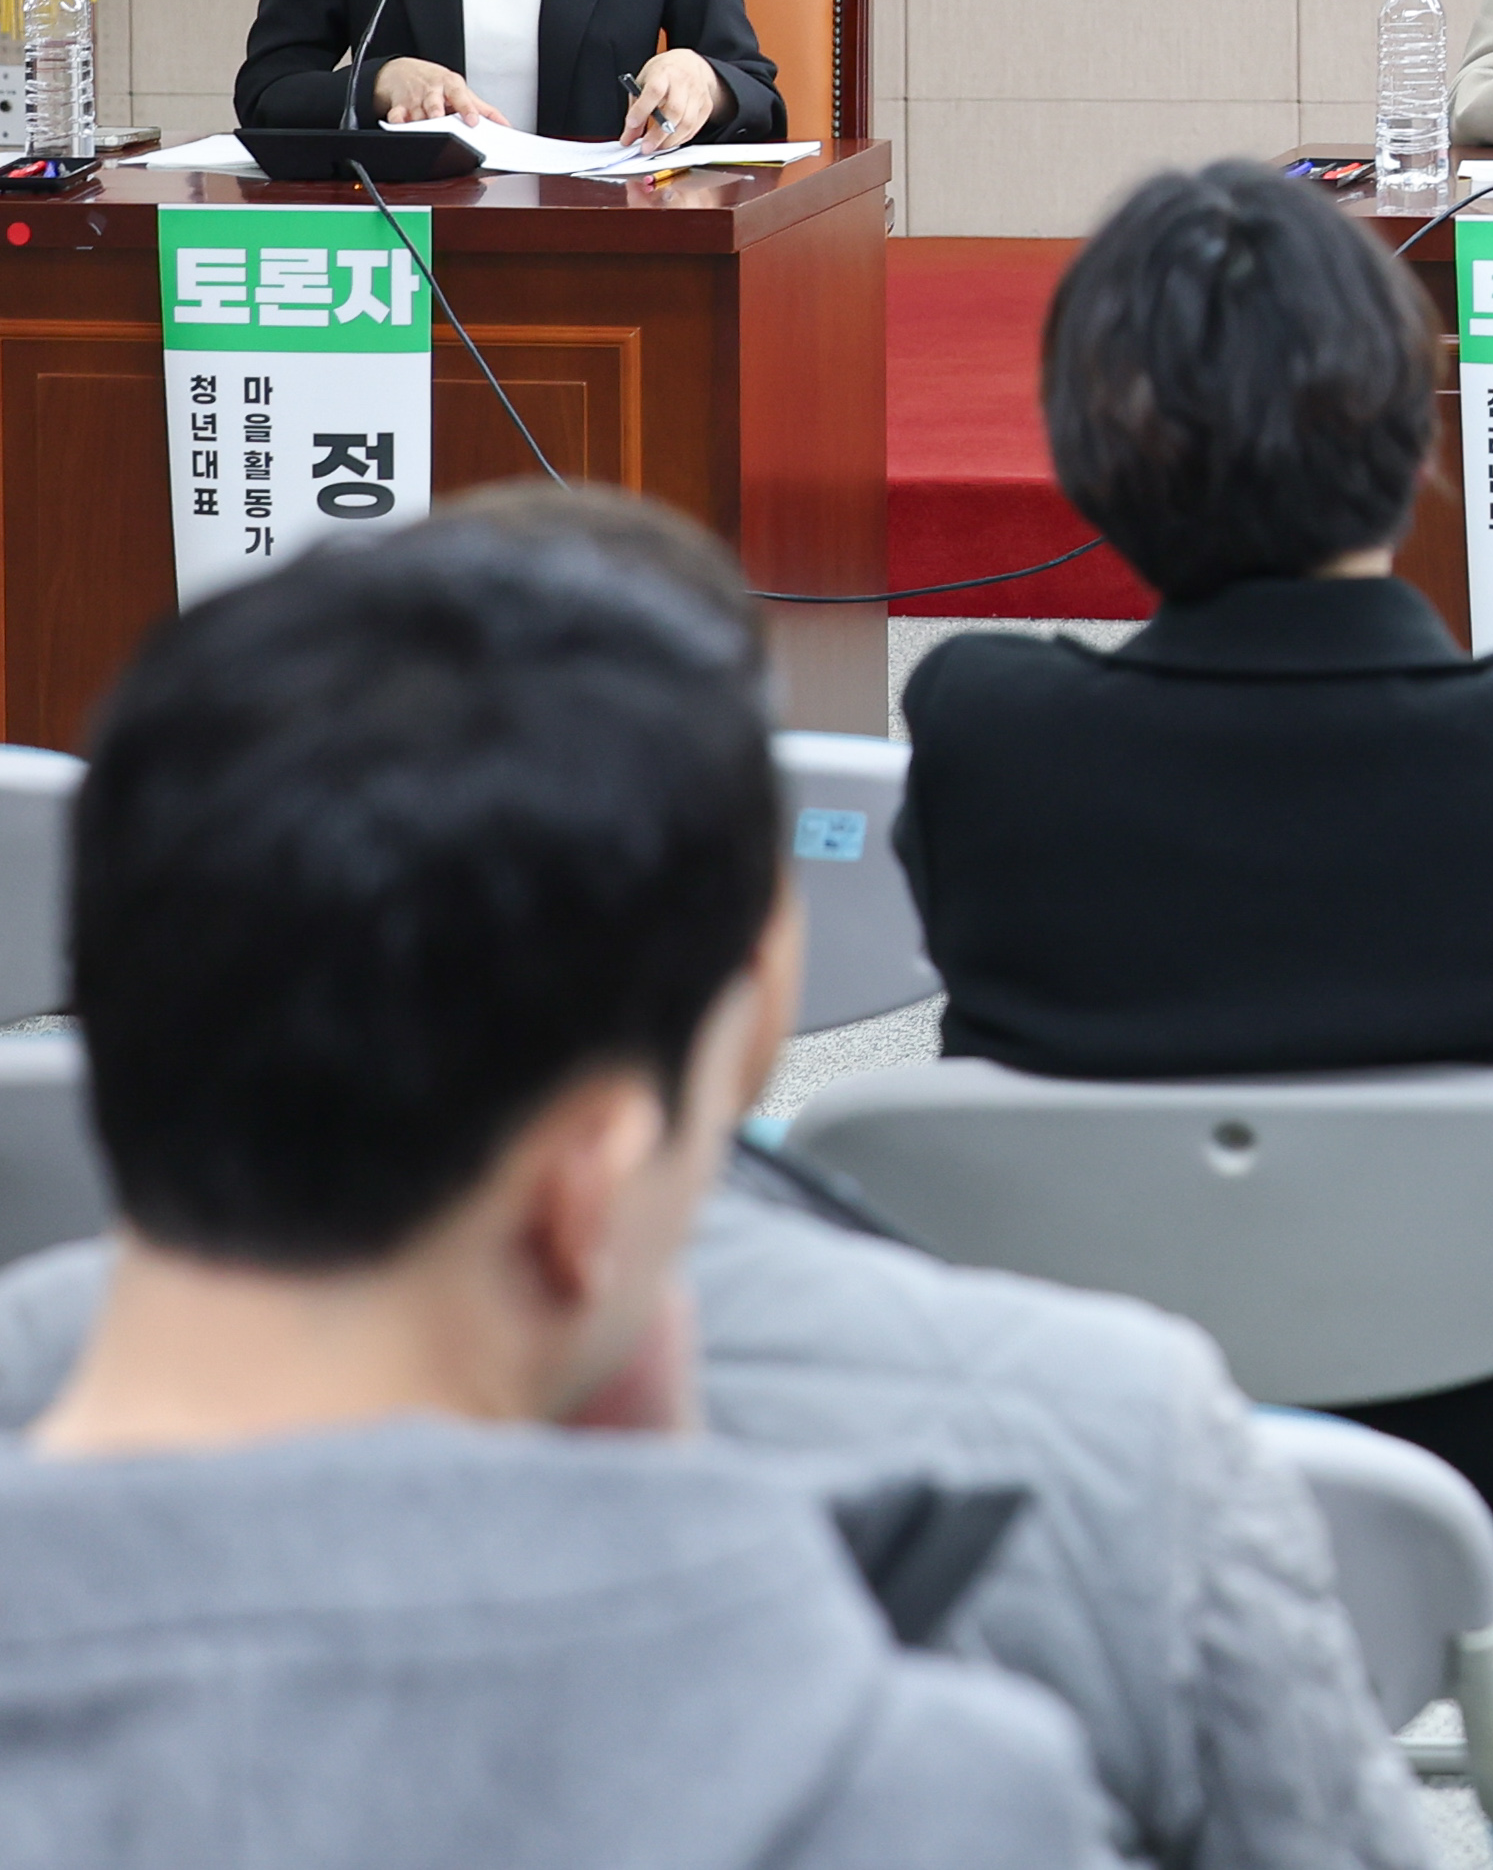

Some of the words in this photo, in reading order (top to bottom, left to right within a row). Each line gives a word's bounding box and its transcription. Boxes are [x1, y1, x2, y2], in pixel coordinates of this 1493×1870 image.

[174, 247, 420, 327] 토론자
[190, 375, 219, 516] 청년대표
[243, 376, 274, 557] 마을활동가
